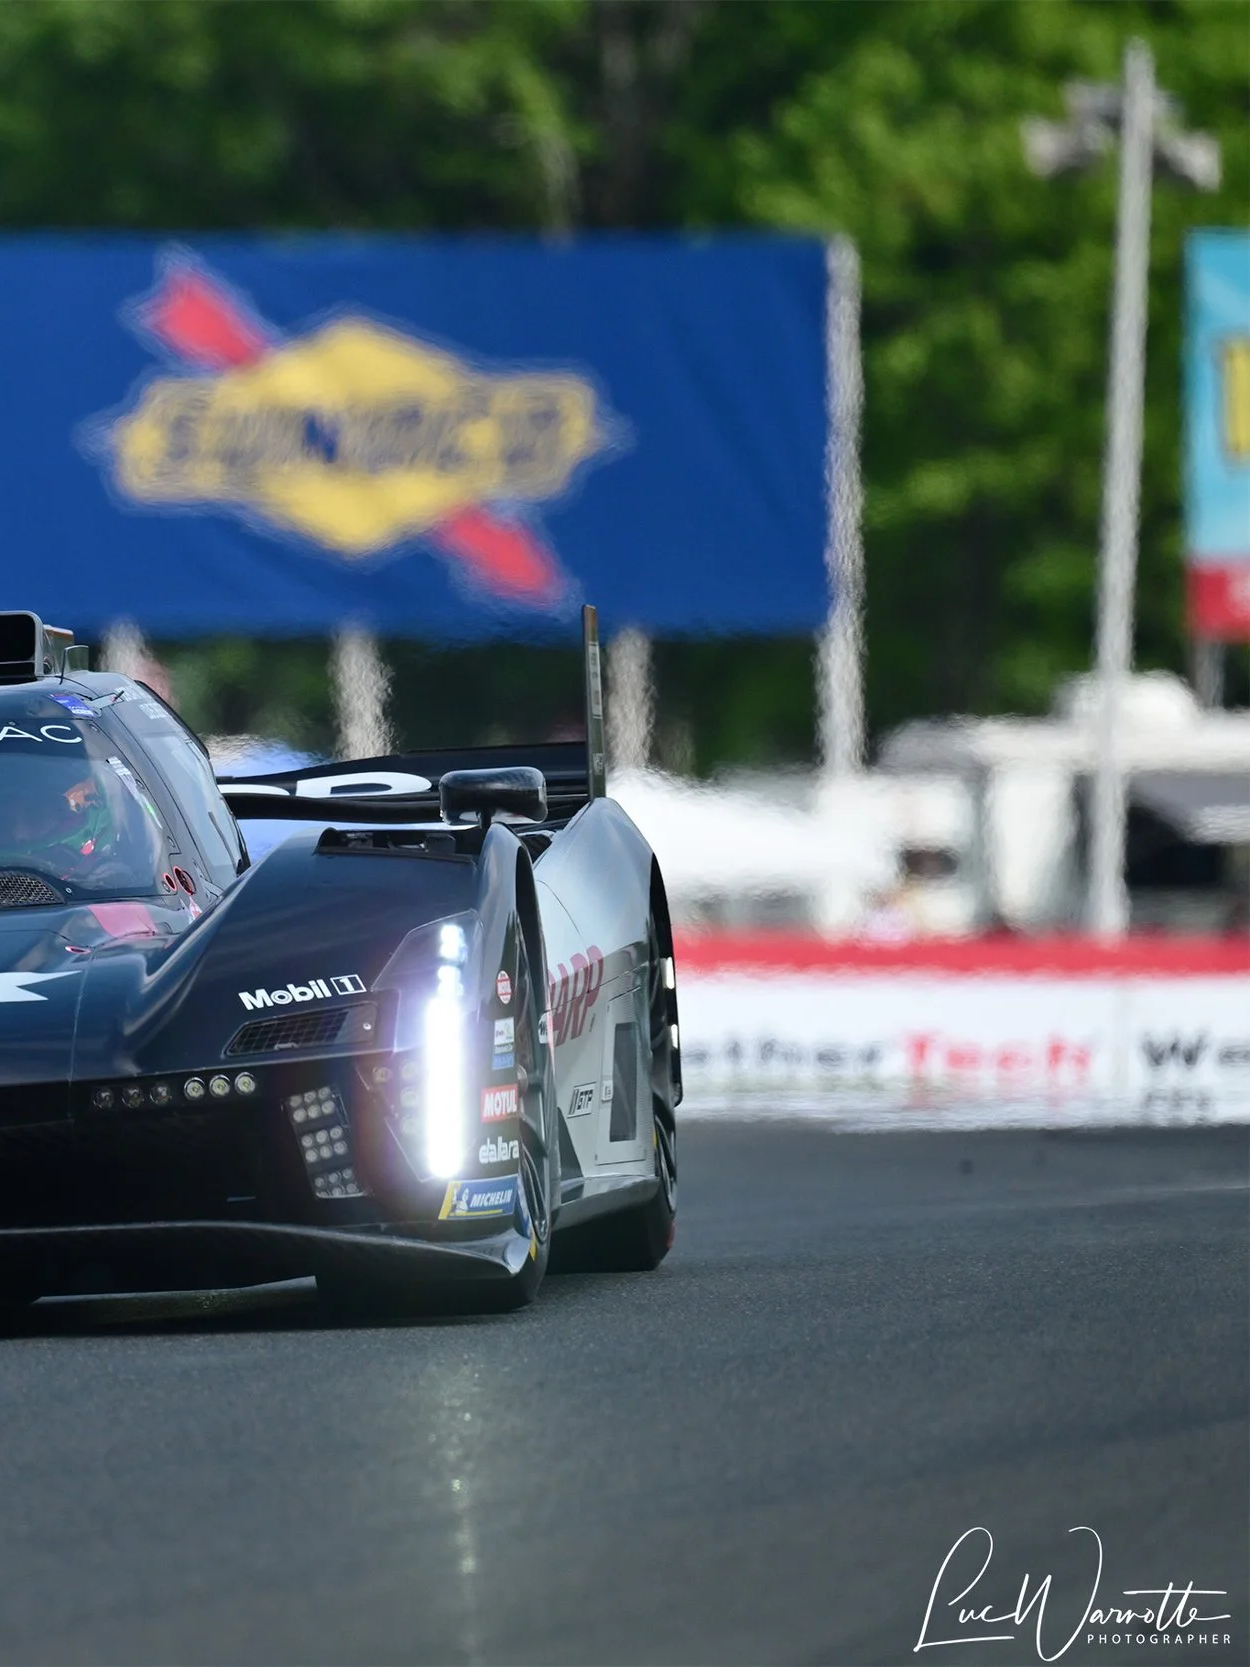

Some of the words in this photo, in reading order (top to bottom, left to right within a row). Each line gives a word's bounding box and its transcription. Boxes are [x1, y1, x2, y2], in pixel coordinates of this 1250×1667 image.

[238, 978, 332, 1010] Mobil
[483, 1089, 518, 1118] MOTUL
[470, 1189, 513, 1208] MICHELIN
